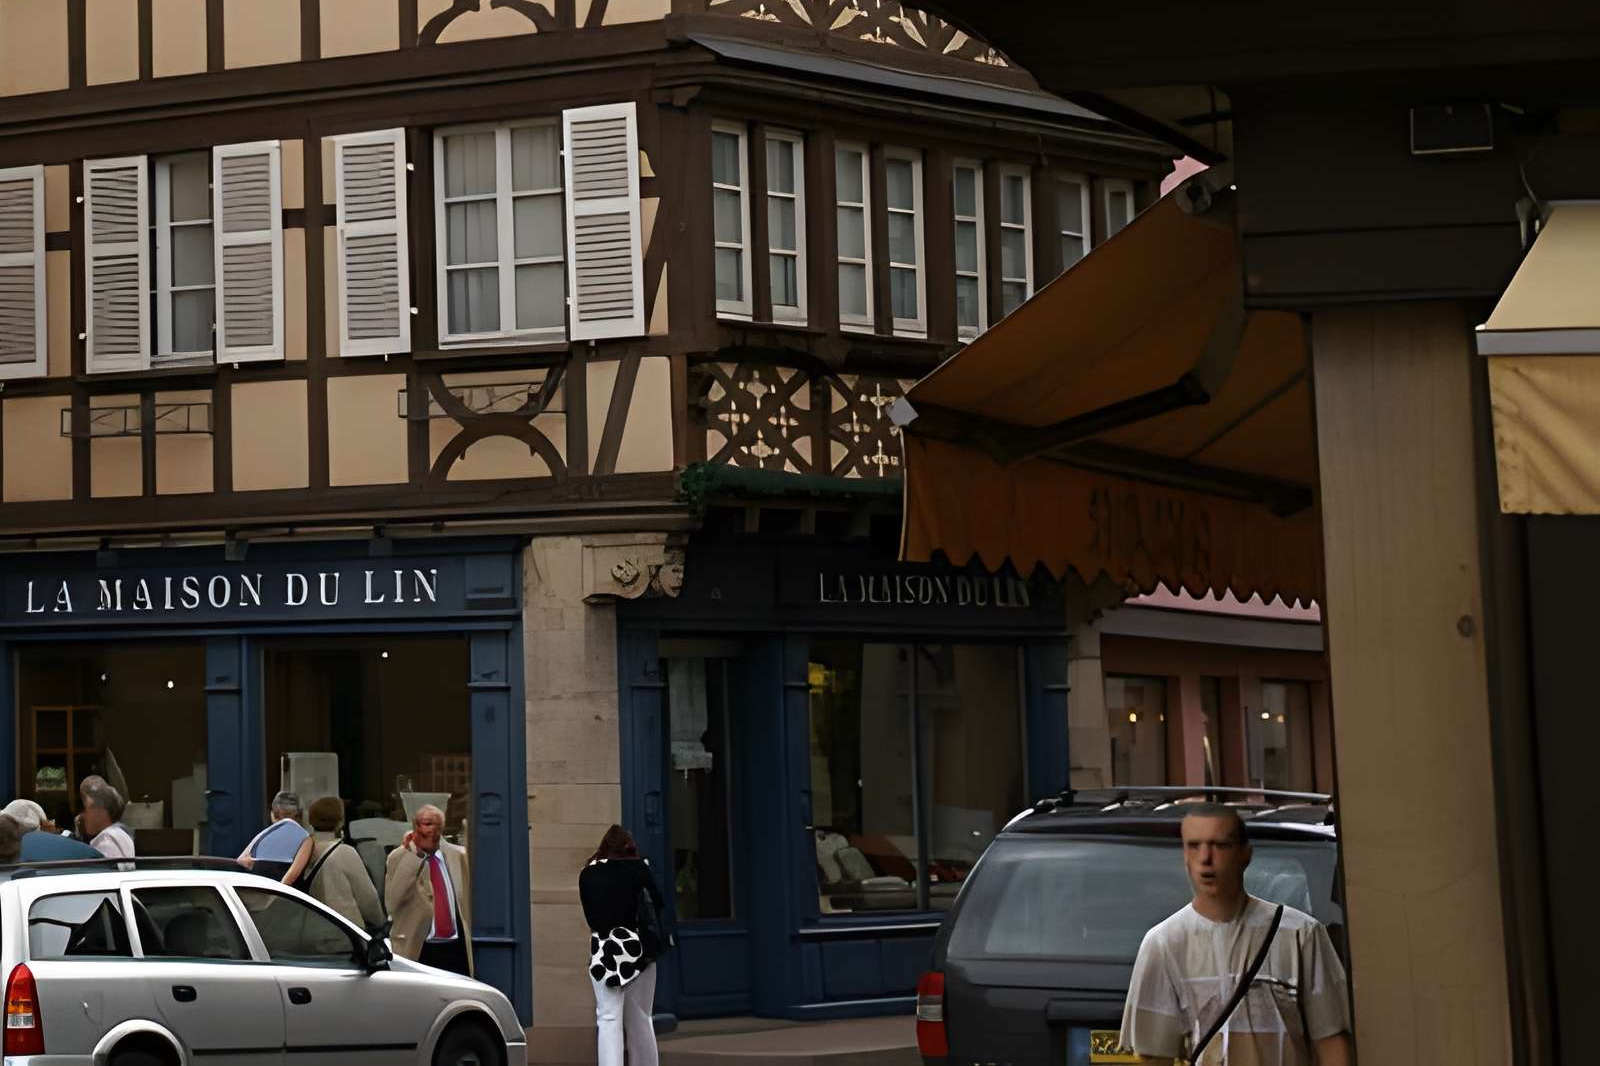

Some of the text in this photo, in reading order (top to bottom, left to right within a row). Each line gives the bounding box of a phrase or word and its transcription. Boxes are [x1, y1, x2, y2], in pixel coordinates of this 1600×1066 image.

[25, 569, 438, 613] LA MAISON DU LIN
[820, 572, 848, 603] LA
